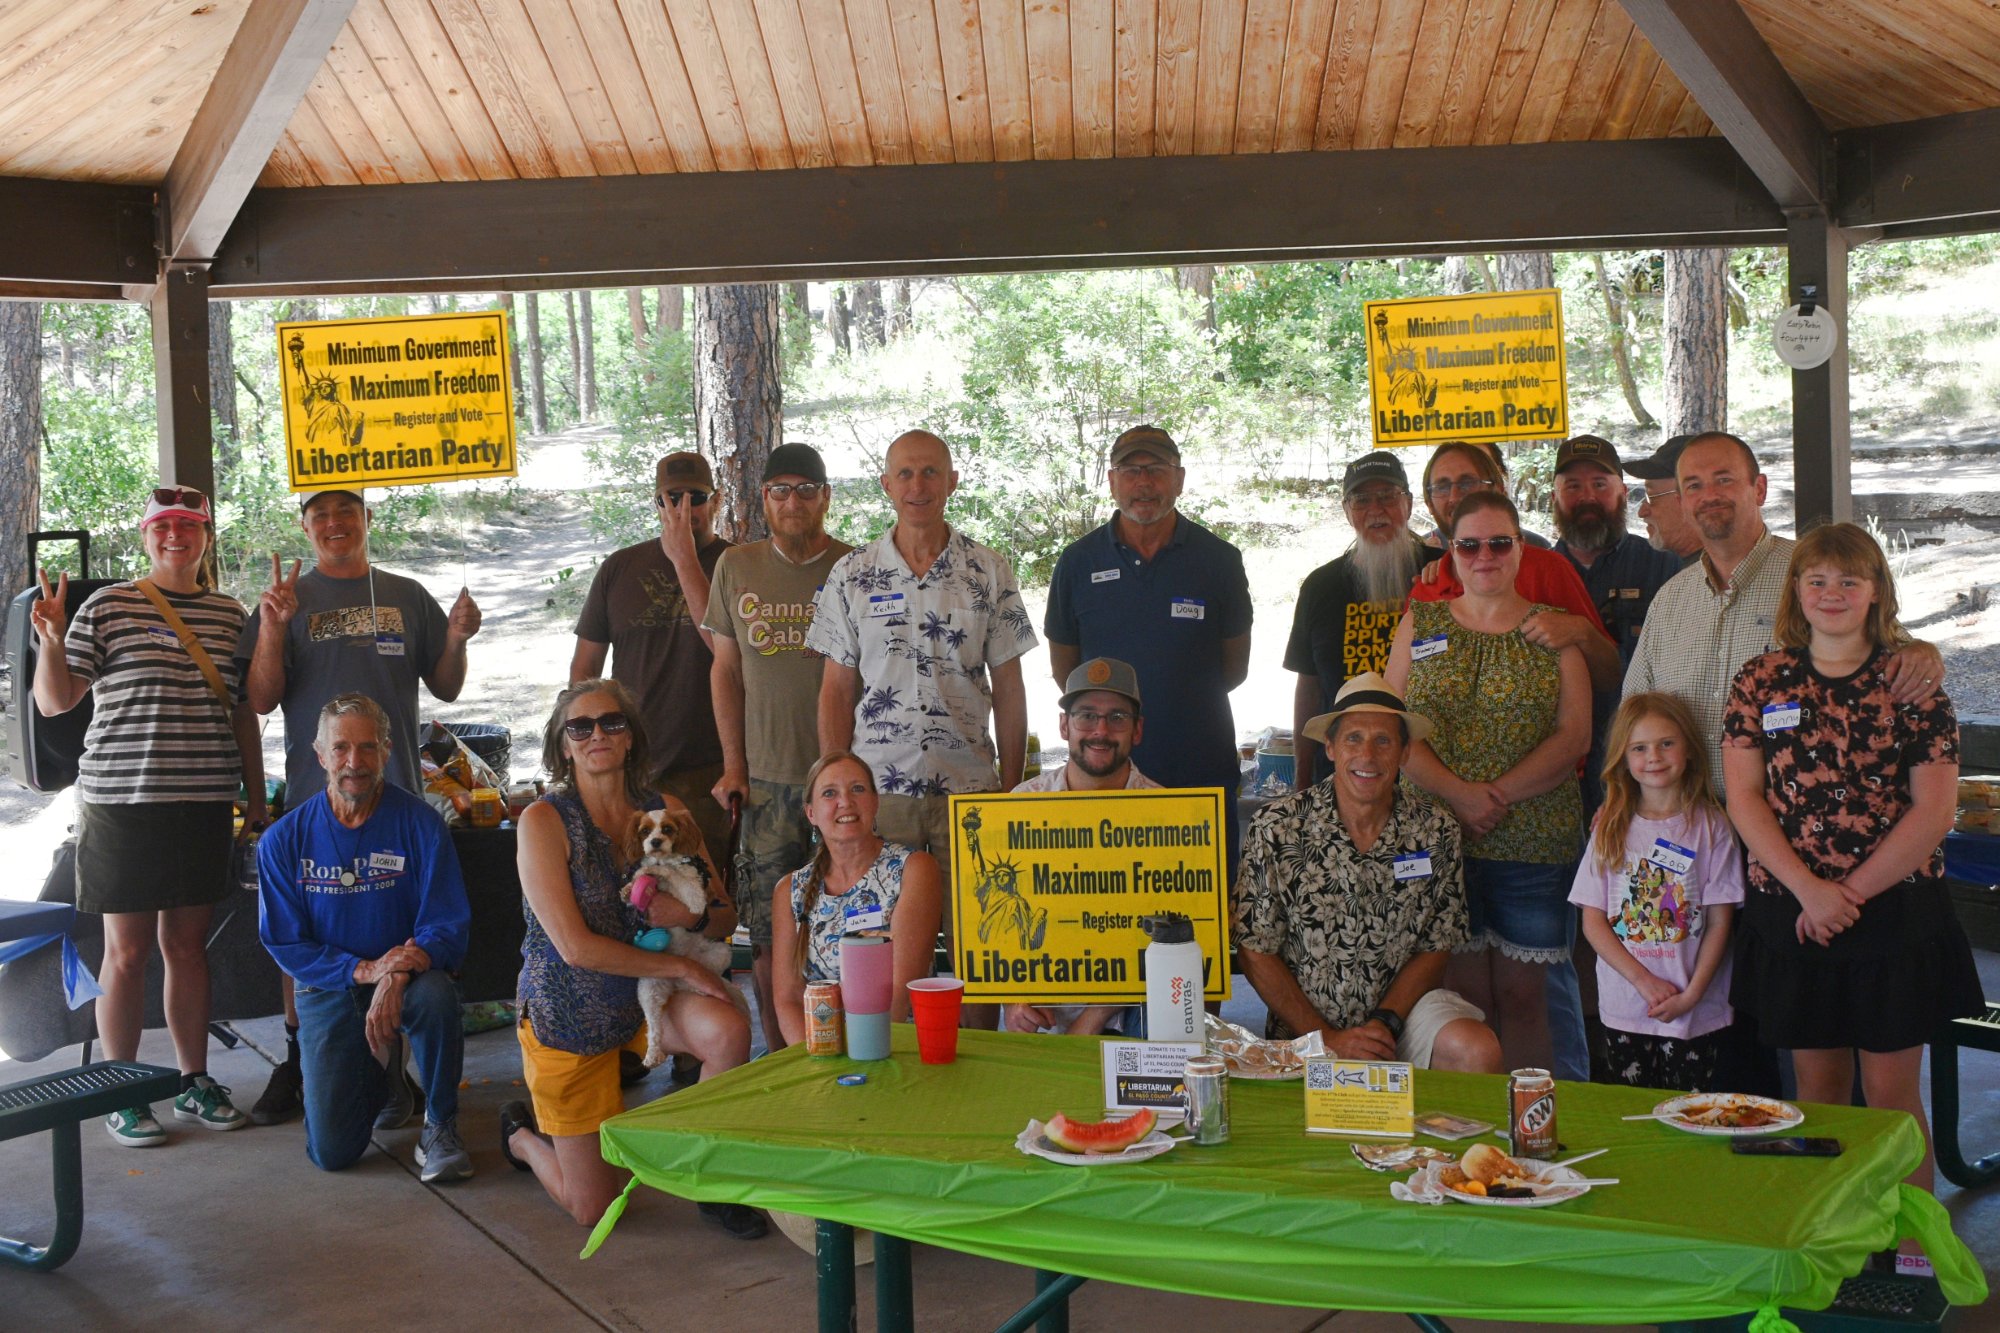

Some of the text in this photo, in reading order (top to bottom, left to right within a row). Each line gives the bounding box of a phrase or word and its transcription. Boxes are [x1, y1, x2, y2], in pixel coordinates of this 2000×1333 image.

[1407, 310, 1554, 338] Minimum Government
[327, 335, 497, 366] Minimum Government
[1425, 340, 1556, 369] Maximum Freedom
[350, 368, 500, 401] Maximum Freedom
[1462, 375, 1540, 394] Register and Vote
[393, 407, 483, 429] Register and Vote
[1379, 403, 1557, 434] Libertarian Party
[296, 439, 503, 476] Libertarian Party
[873, 603, 896, 613] Keith
[1176, 604, 1199, 618] Doug
[1345, 611, 1402, 630] HURT
[1344, 628, 1384, 645] PPL
[1766, 714, 1799, 728] Penny
[1007, 818, 1211, 849] Minimum Government
[300, 858, 343, 879] Ron
[373, 856, 398, 867] JOHN
[1398, 863, 1416, 873] Joe
[305, 880, 395, 895] FOR PRESIDENT 2008
[1032, 861, 1213, 895] Maximum Freedom
[1082, 911, 1133, 933] Register
[966, 949, 1126, 983] Libertarian
[1183, 980, 1194, 1034] canvas
[1128, 1083, 1172, 1091] LIBERTARIAN
